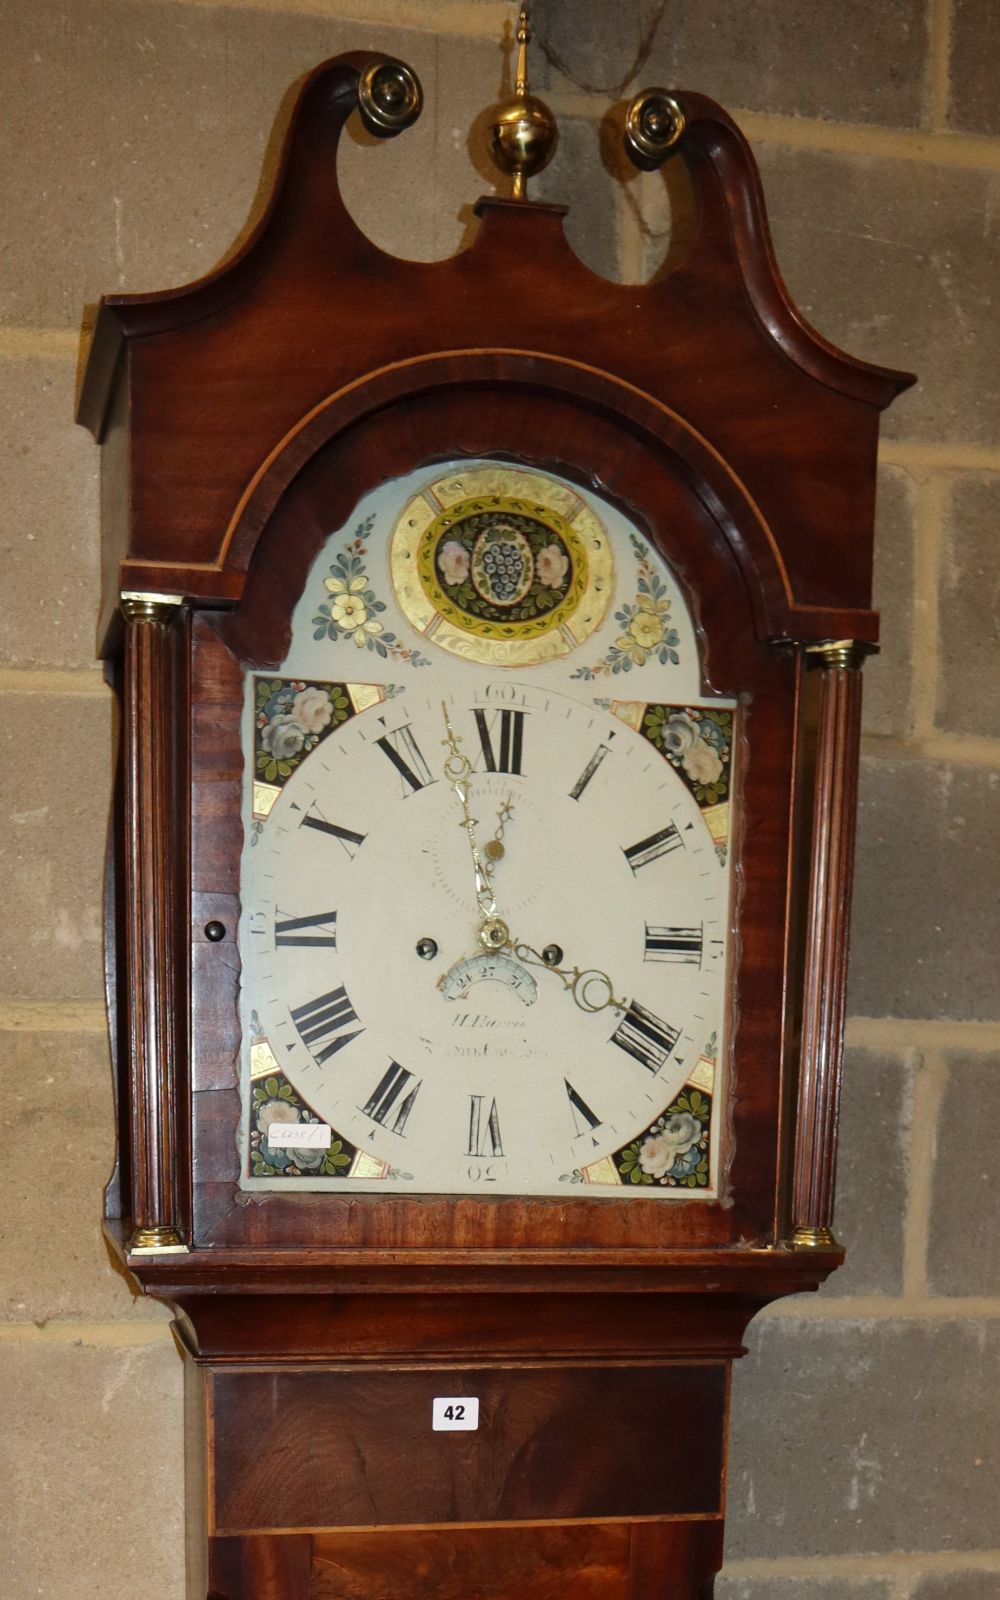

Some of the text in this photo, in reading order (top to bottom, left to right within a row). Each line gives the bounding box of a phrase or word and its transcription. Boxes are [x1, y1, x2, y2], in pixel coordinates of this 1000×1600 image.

[373, 723, 439, 799] XI
[469, 708, 531, 778] XII
[298, 799, 369, 862] X
[620, 819, 687, 878] II
[275, 904, 338, 953] IX
[644, 920, 703, 971] III
[287, 981, 366, 1071] VIII
[355, 1056, 423, 1139] VII
[463, 1094, 506, 1158] VI
[563, 1077, 606, 1139] V
[443, 1405, 466, 1421] 42
